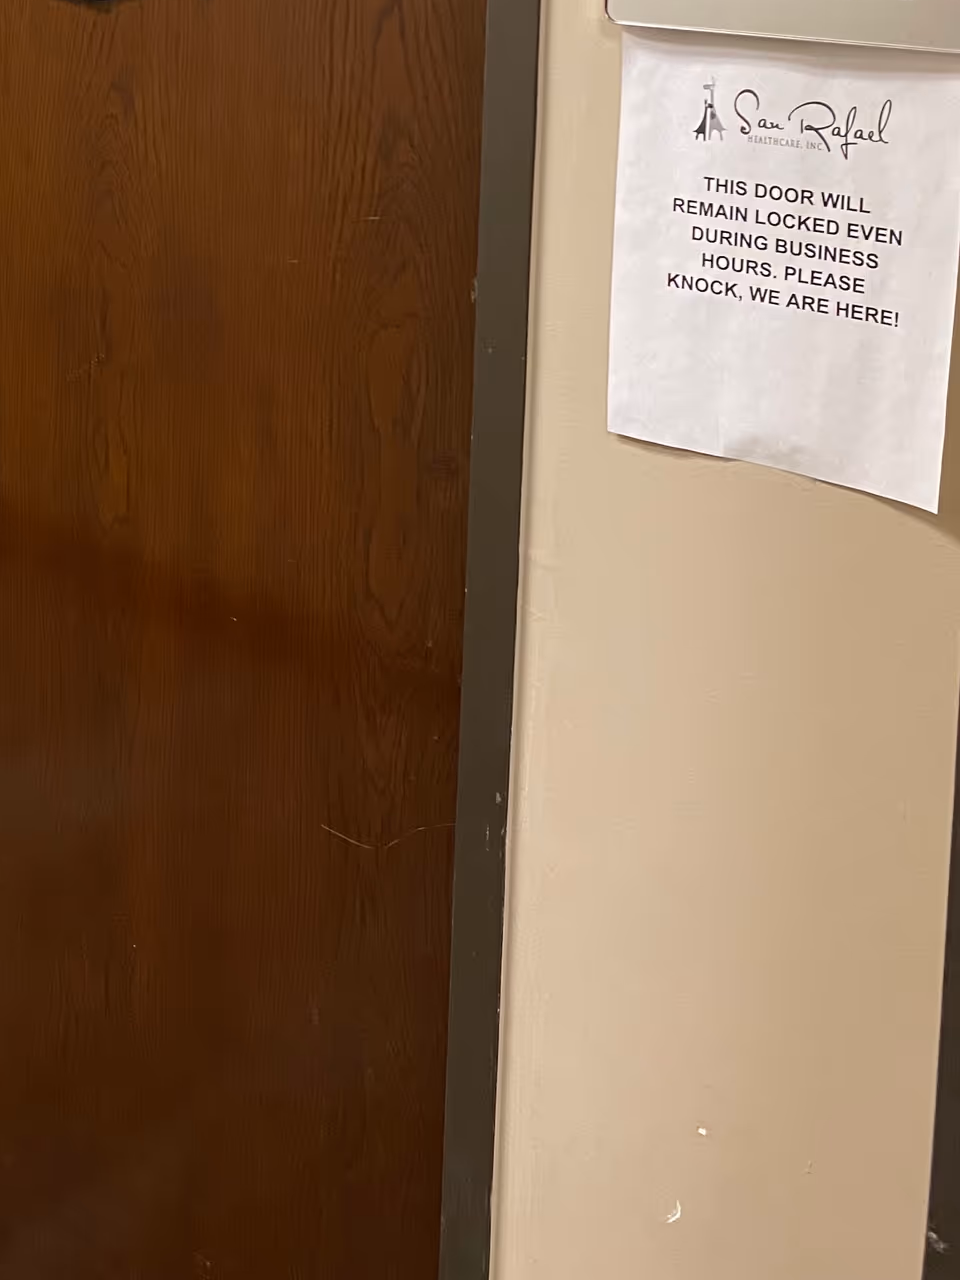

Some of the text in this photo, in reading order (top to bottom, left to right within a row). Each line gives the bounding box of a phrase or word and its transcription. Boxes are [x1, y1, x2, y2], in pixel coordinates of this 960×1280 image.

[734, 88, 892, 160] San Rafael
[747, 134, 825, 151] HEALTHCARE, INC.
[704, 176, 871, 214] THIS DOOR WILL
[673, 197, 903, 246] REMAIN LOCKED EVEN
[691, 225, 879, 269] DURING BUSINESS
[702, 252, 866, 294] HOURS. PLEASE
[667, 272, 900, 328] KNOCK, WE ARE HERE!
